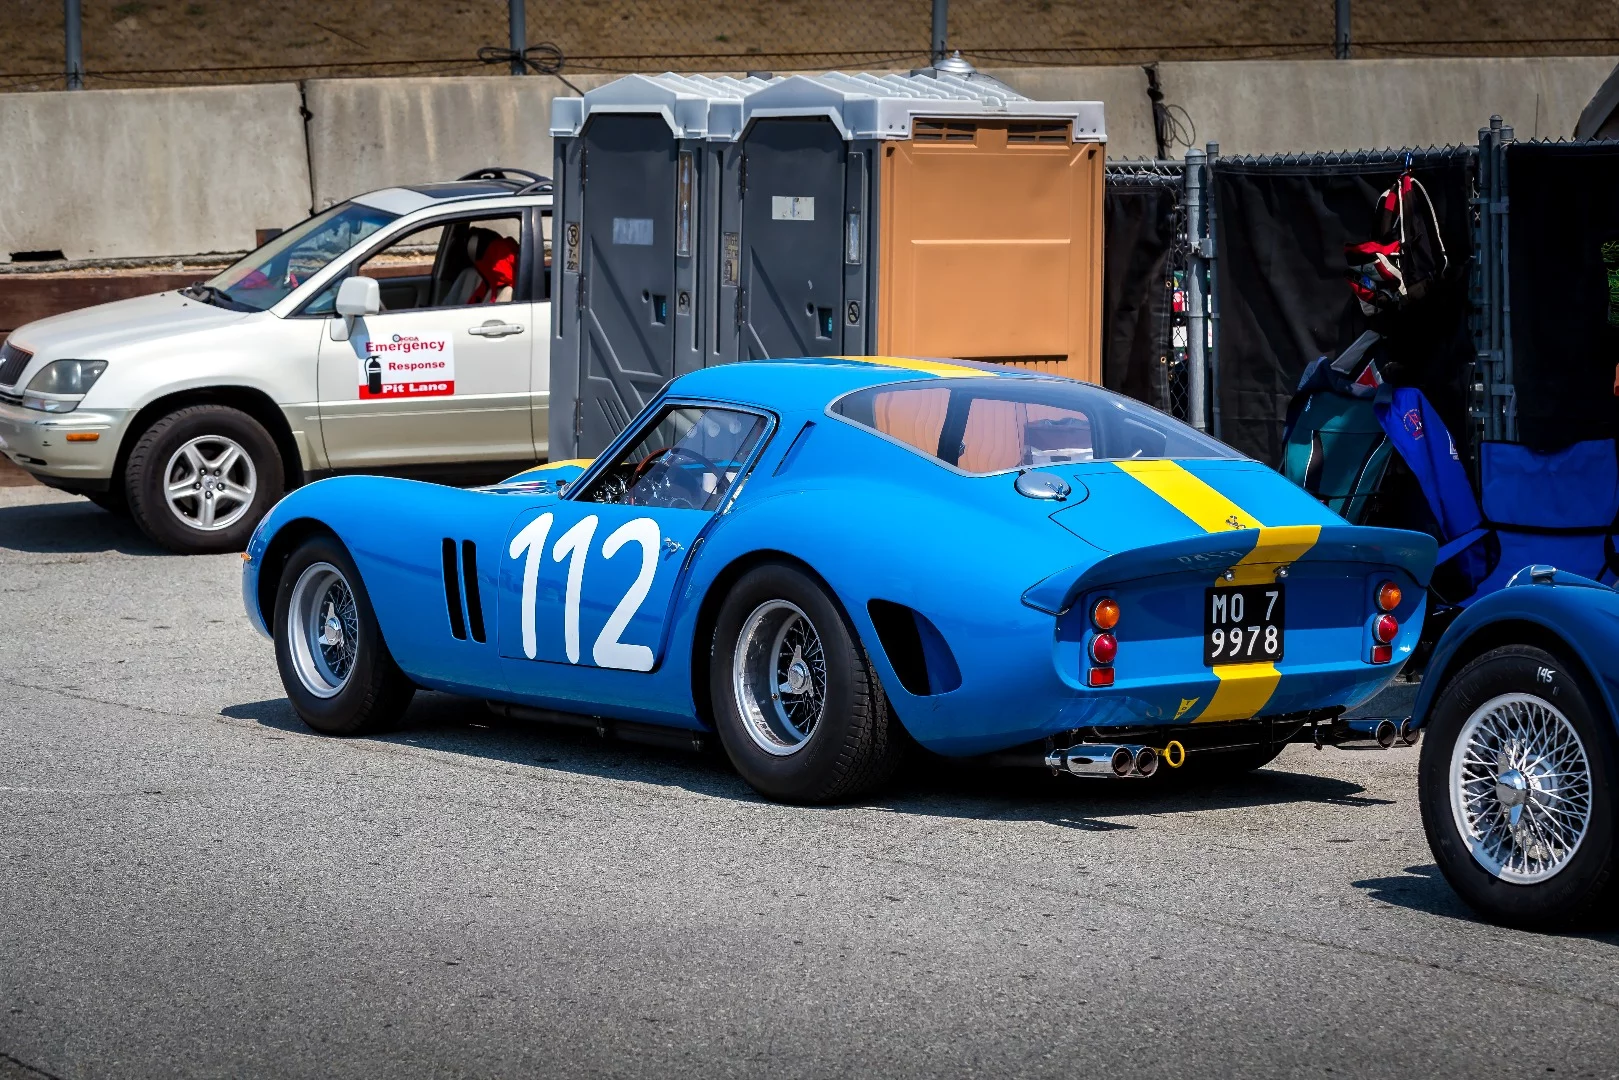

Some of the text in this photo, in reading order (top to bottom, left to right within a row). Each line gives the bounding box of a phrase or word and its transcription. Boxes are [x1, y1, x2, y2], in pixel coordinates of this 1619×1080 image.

[365, 341, 445, 353] Emergency
[389, 361, 445, 371] Response
[382, 383, 447, 394] Pit Lane
[509, 512, 660, 672] 112
[1212, 591, 1278, 624] MO 7
[1211, 625, 1278, 658] 9978
